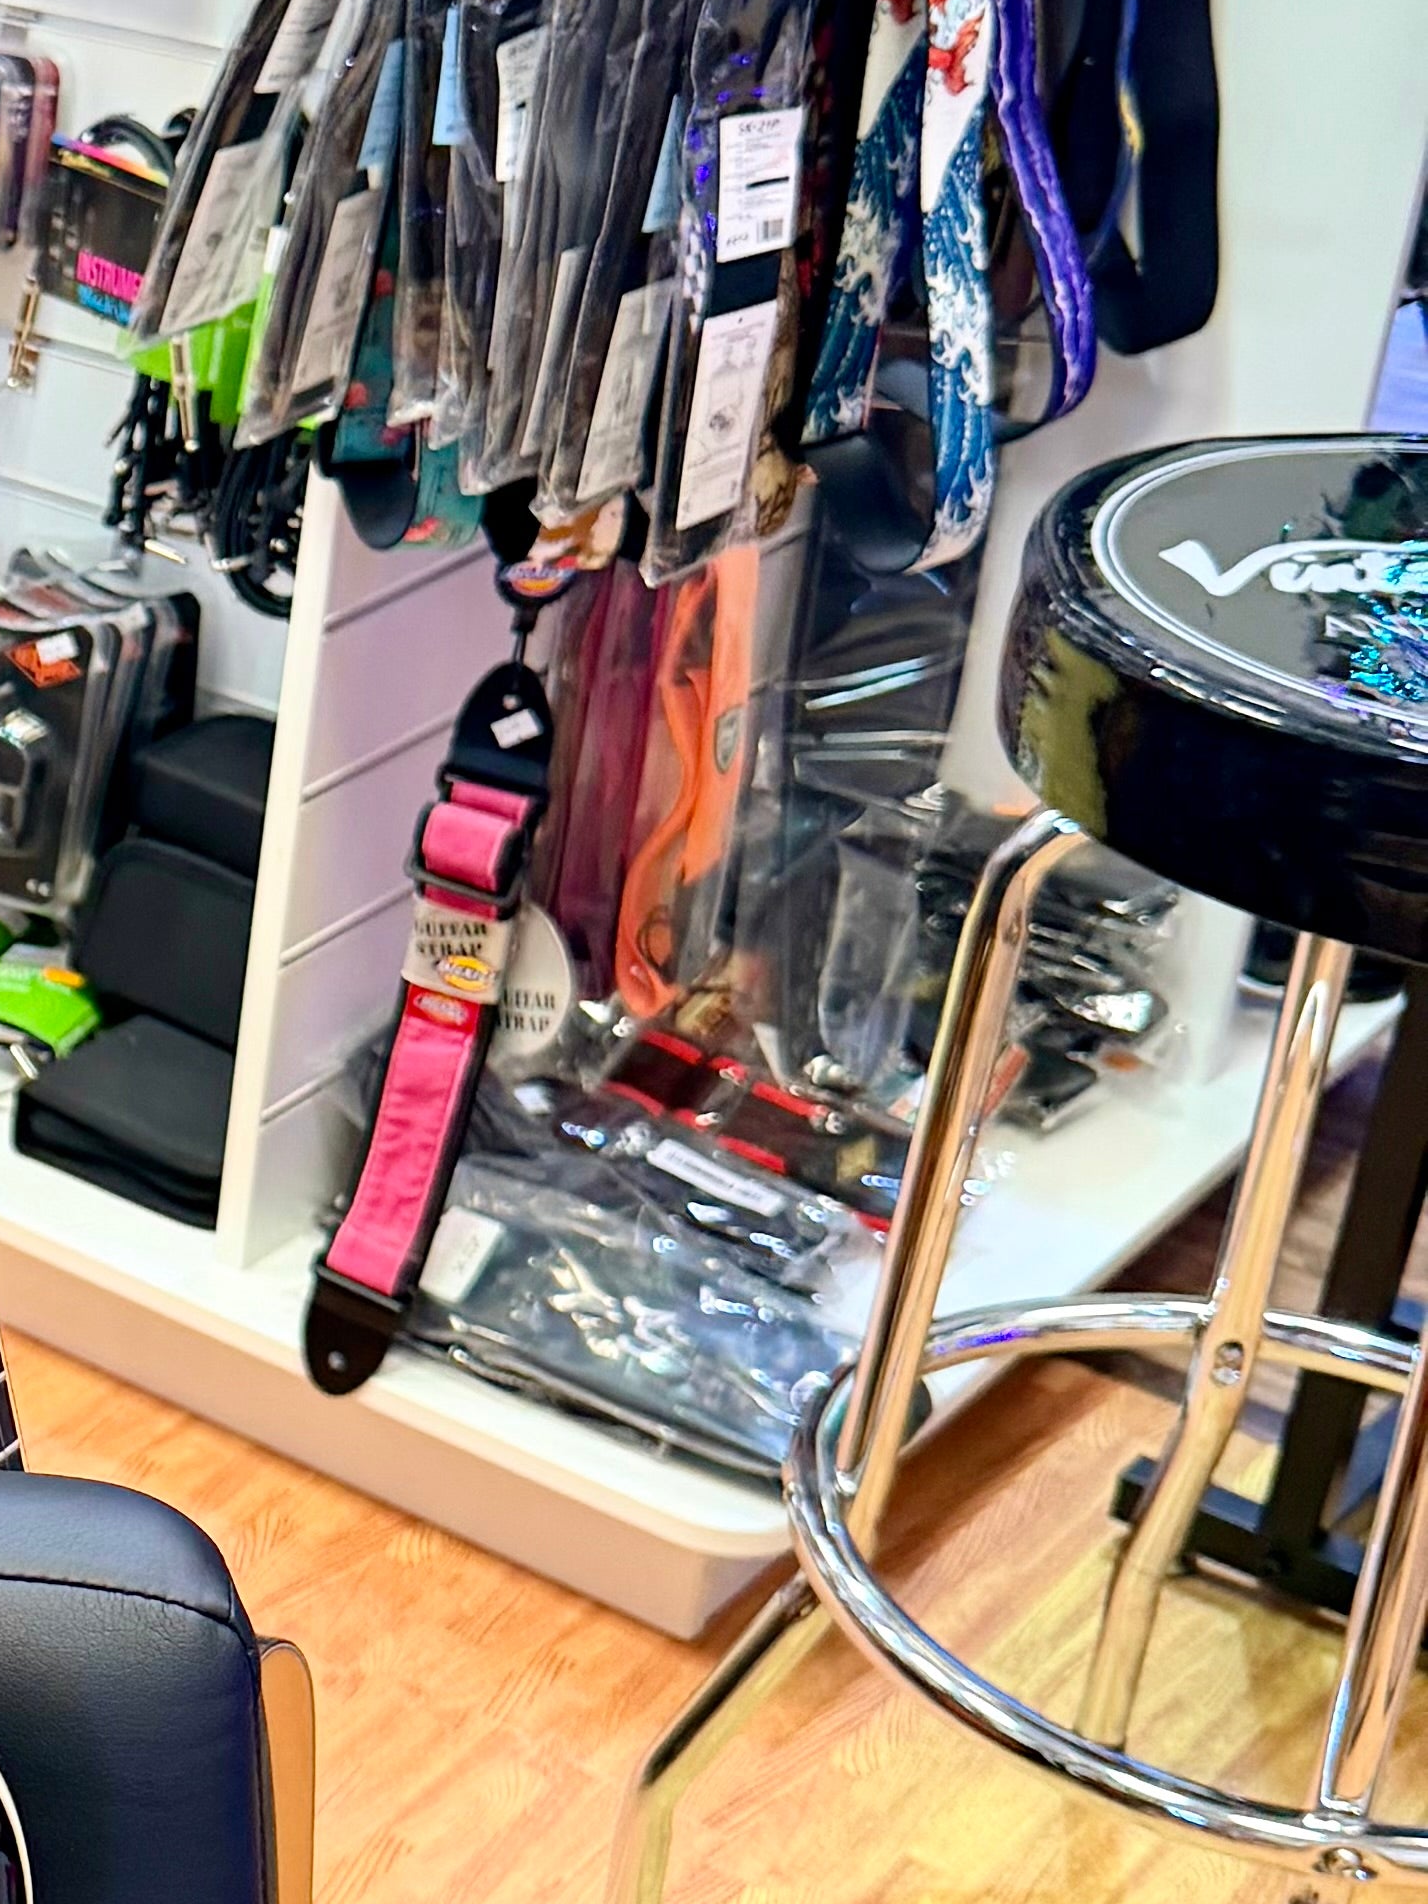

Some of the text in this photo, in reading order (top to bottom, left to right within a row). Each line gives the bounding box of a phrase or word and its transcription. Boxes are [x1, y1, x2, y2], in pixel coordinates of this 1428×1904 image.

[414, 920, 488, 939] GUITAR
[416, 940, 483, 959] STRAP
[501, 990, 555, 1010] UITAR
